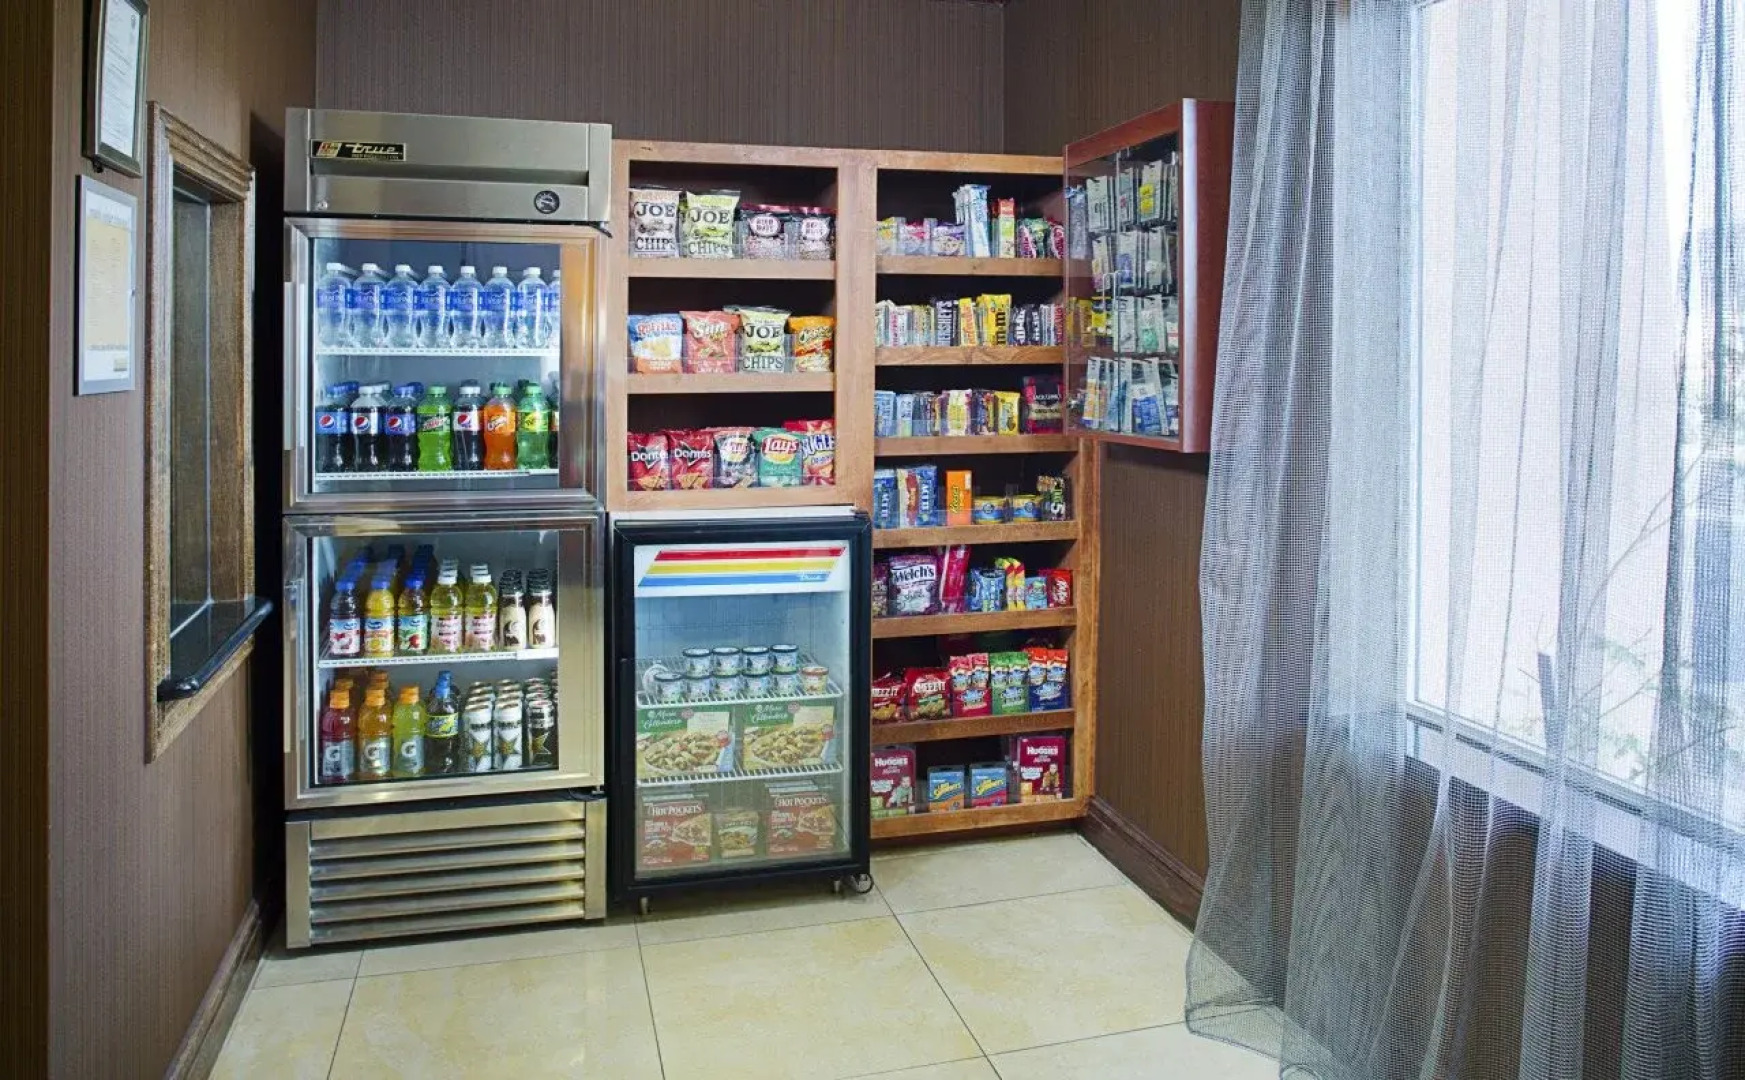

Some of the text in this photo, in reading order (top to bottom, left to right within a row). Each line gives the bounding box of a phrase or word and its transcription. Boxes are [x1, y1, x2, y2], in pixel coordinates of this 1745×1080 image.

[636, 204, 676, 218] JOE
[691, 207, 731, 224] JOE
[746, 325, 781, 339] JOE
[742, 355, 784, 370] CHIPS
[893, 565, 935, 583] Welch's
